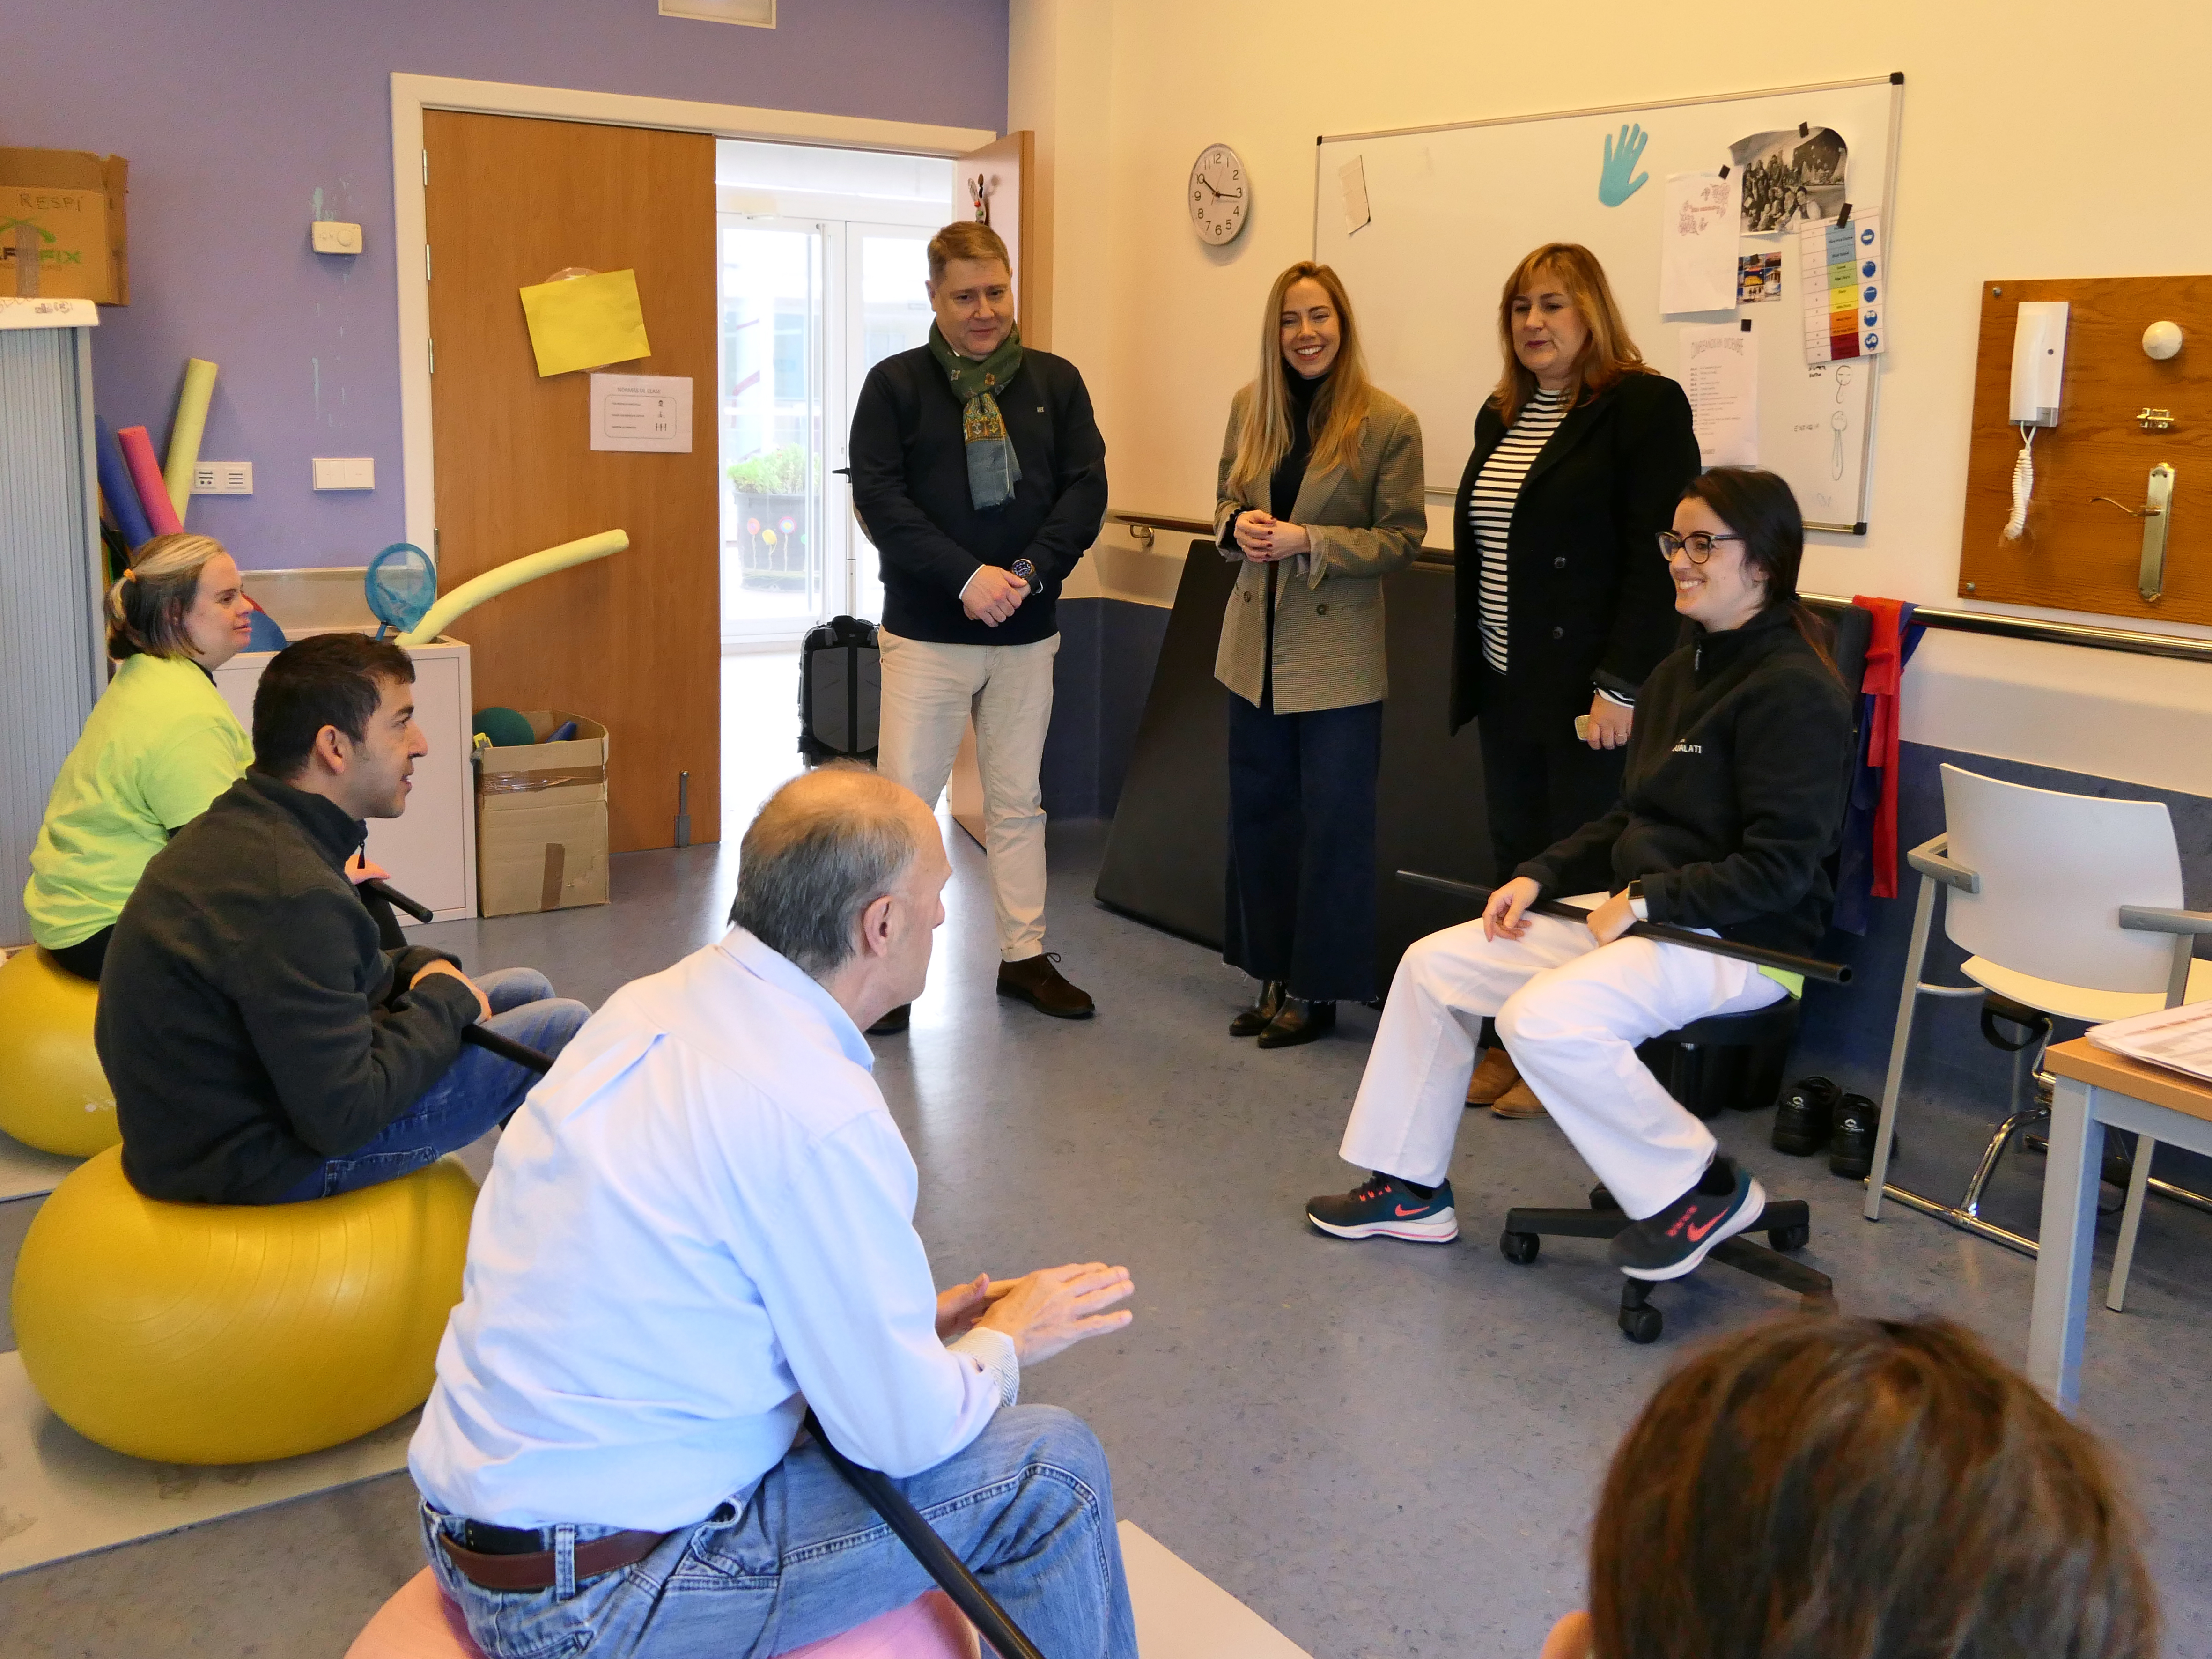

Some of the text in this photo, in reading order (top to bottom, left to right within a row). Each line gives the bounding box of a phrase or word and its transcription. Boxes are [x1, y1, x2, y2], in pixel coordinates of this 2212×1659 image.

[1213, 153, 1221, 164] 12
[1226, 157, 1229, 168] 1
[1204, 159, 1210, 170] 11
[1196, 174, 1205, 184] 10
[1232, 170, 1239, 180] 2
[1194, 191, 1201, 201] 9
[1236, 187, 1242, 199] 3
[19, 193, 81, 212] RESPI
[1198, 208, 1204, 219] 8
[1233, 206, 1239, 216] 4
[1205, 221, 1211, 231] 7
[1225, 219, 1232, 230] 5
[1215, 225, 1222, 236] 6
